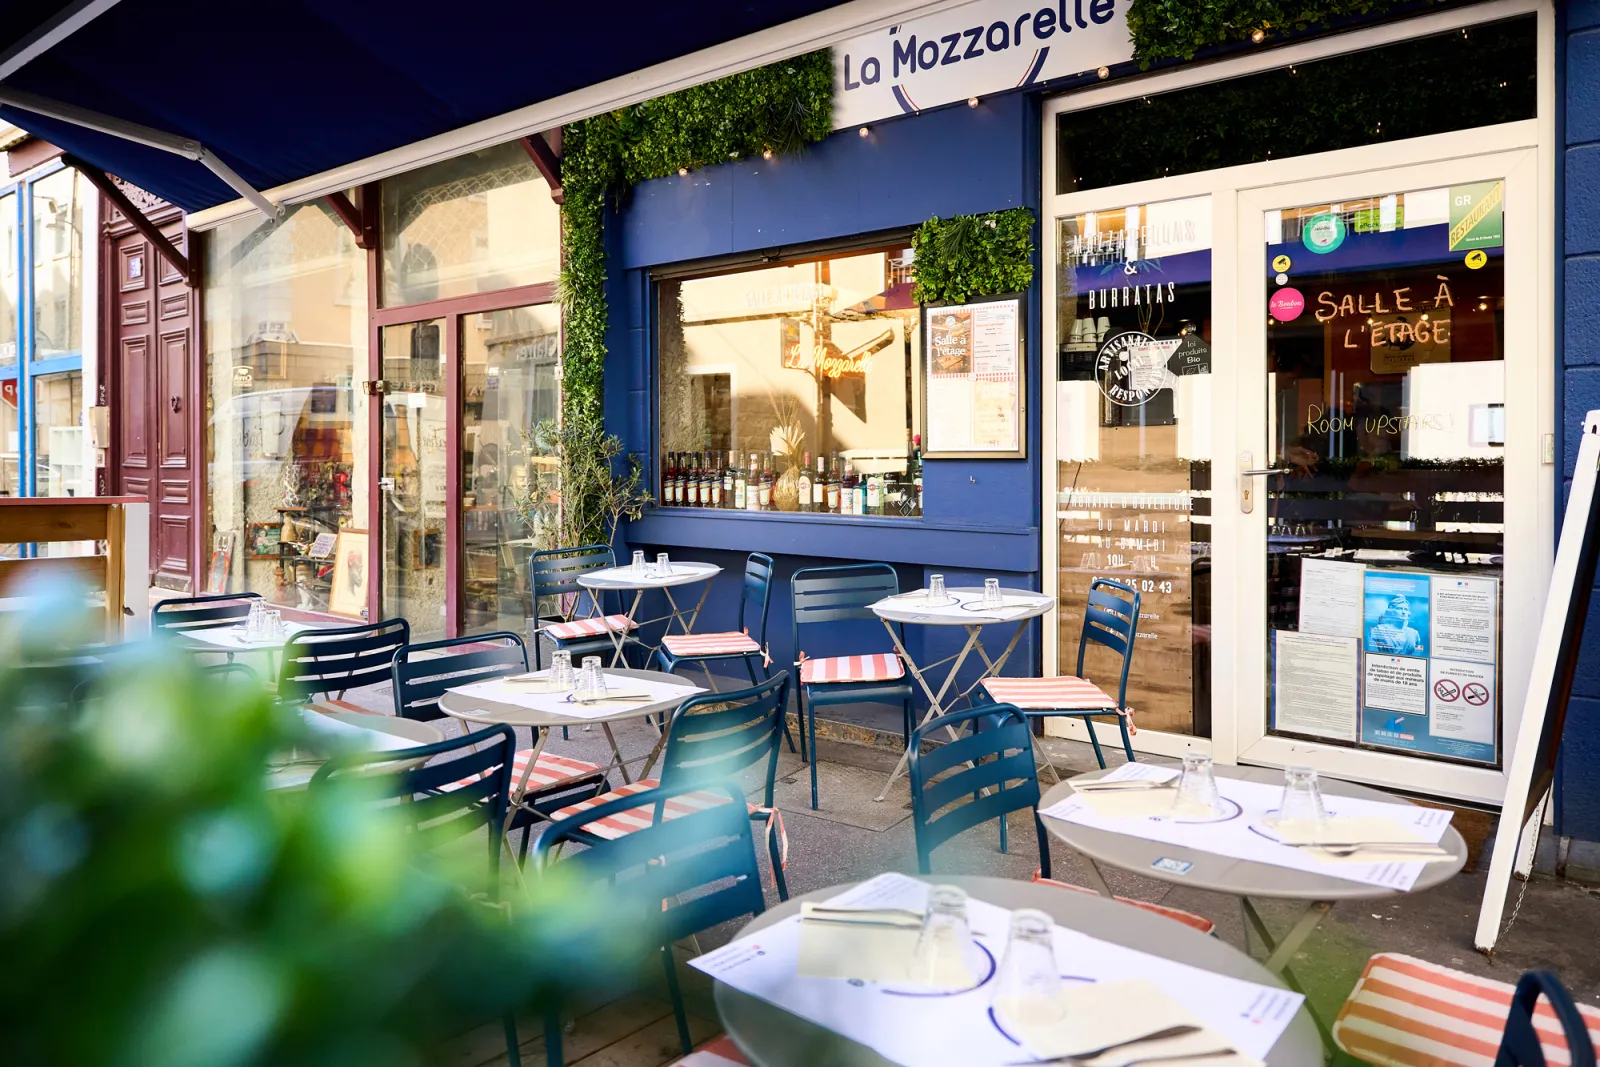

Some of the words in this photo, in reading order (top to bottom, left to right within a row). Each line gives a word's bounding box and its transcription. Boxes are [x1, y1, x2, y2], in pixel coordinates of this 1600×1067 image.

[844, 53, 880, 91] La
[893, 0, 1115, 78] Mozzarelle
[1123, 260, 1137, 275] &
[1088, 281, 1175, 310] BURRATAS
[1314, 287, 1413, 321] SALLE
[1433, 274, 1454, 307] À
[934, 335, 958, 346] Salle
[959, 334, 967, 344] à
[1098, 335, 1148, 371] ARTISANAL
[1186, 356, 1201, 364] Bio
[1307, 403, 1354, 434] ROOM
[1098, 519, 1112, 531] DU
[1124, 519, 1165, 534] MARDI
[1098, 536, 1111, 549] AU
[1141, 580, 1155, 593] 02
[1158, 581, 1172, 594] 43
